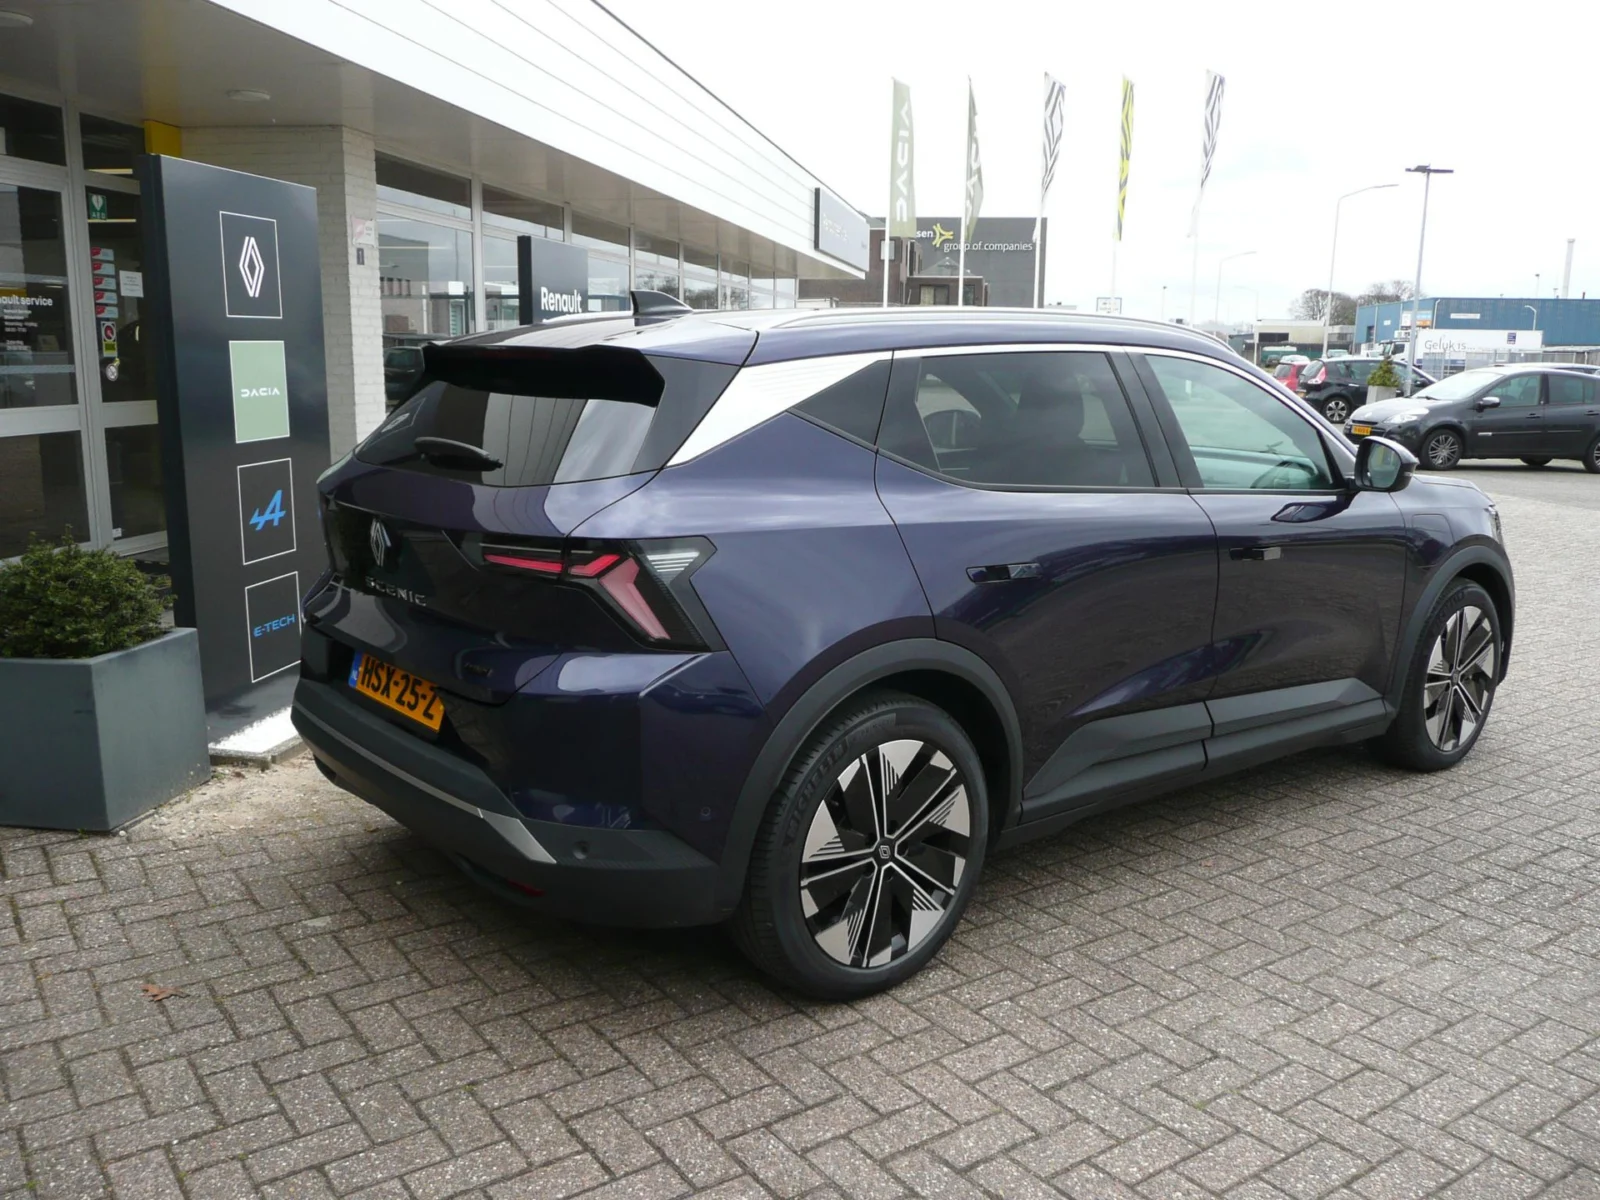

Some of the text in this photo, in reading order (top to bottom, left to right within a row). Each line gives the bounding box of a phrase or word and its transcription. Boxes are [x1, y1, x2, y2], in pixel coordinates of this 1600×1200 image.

[915, 230, 934, 238] sen
[972, 241, 983, 250] of
[984, 242, 1033, 252] companies
[21, 295, 54, 306] service
[541, 286, 582, 313] Renault
[240, 387, 280, 398] DACIA
[365, 576, 427, 607] SCENIC
[253, 613, 296, 638] E-TECH
